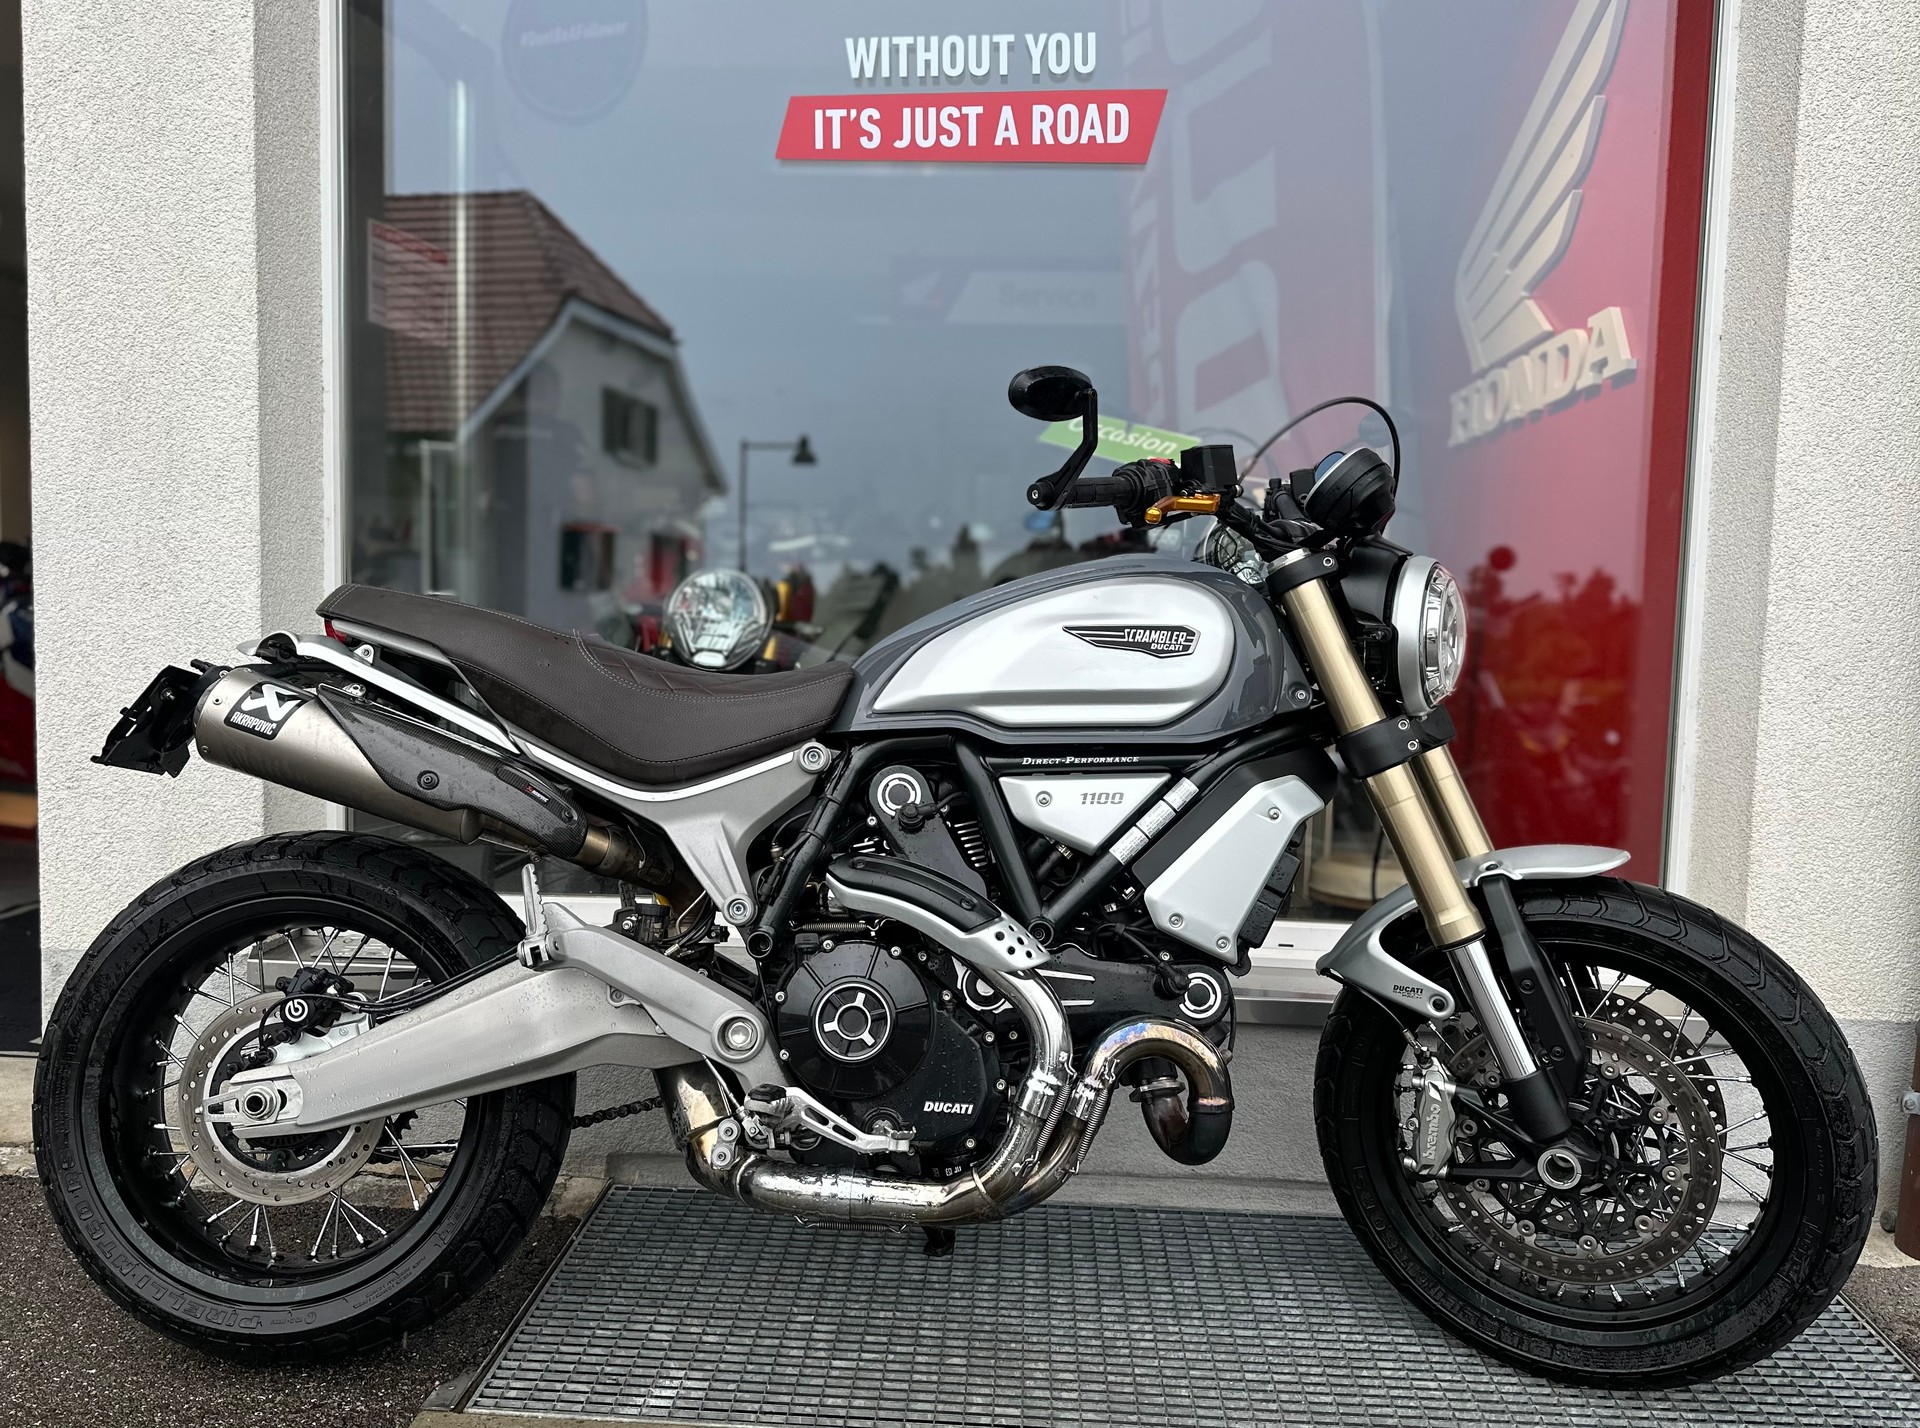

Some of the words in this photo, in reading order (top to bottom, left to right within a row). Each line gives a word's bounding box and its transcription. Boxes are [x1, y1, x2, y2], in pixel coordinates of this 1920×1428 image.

[845, 34, 1015, 79] WITHOUT
[1024, 32, 1096, 75] YOU
[814, 107, 881, 150] IT'S
[893, 105, 983, 148] JUST
[994, 105, 1019, 146] A
[1032, 103, 1129, 145] ROAD
[1447, 306, 1638, 448] HONDA
[1067, 417, 1179, 455] Ocasion
[1123, 628, 1187, 645] SCRAMBLER
[1150, 643, 1183, 651] DUCATI
[1080, 792, 1124, 805] 1100
[1392, 984, 1424, 994] DUCATI
[923, 1101, 974, 1115] DUCATI
[1422, 1103, 1441, 1160] brembo
[75, 1200, 140, 1277] MT60
[133, 1274, 262, 1330] PIRELLI
